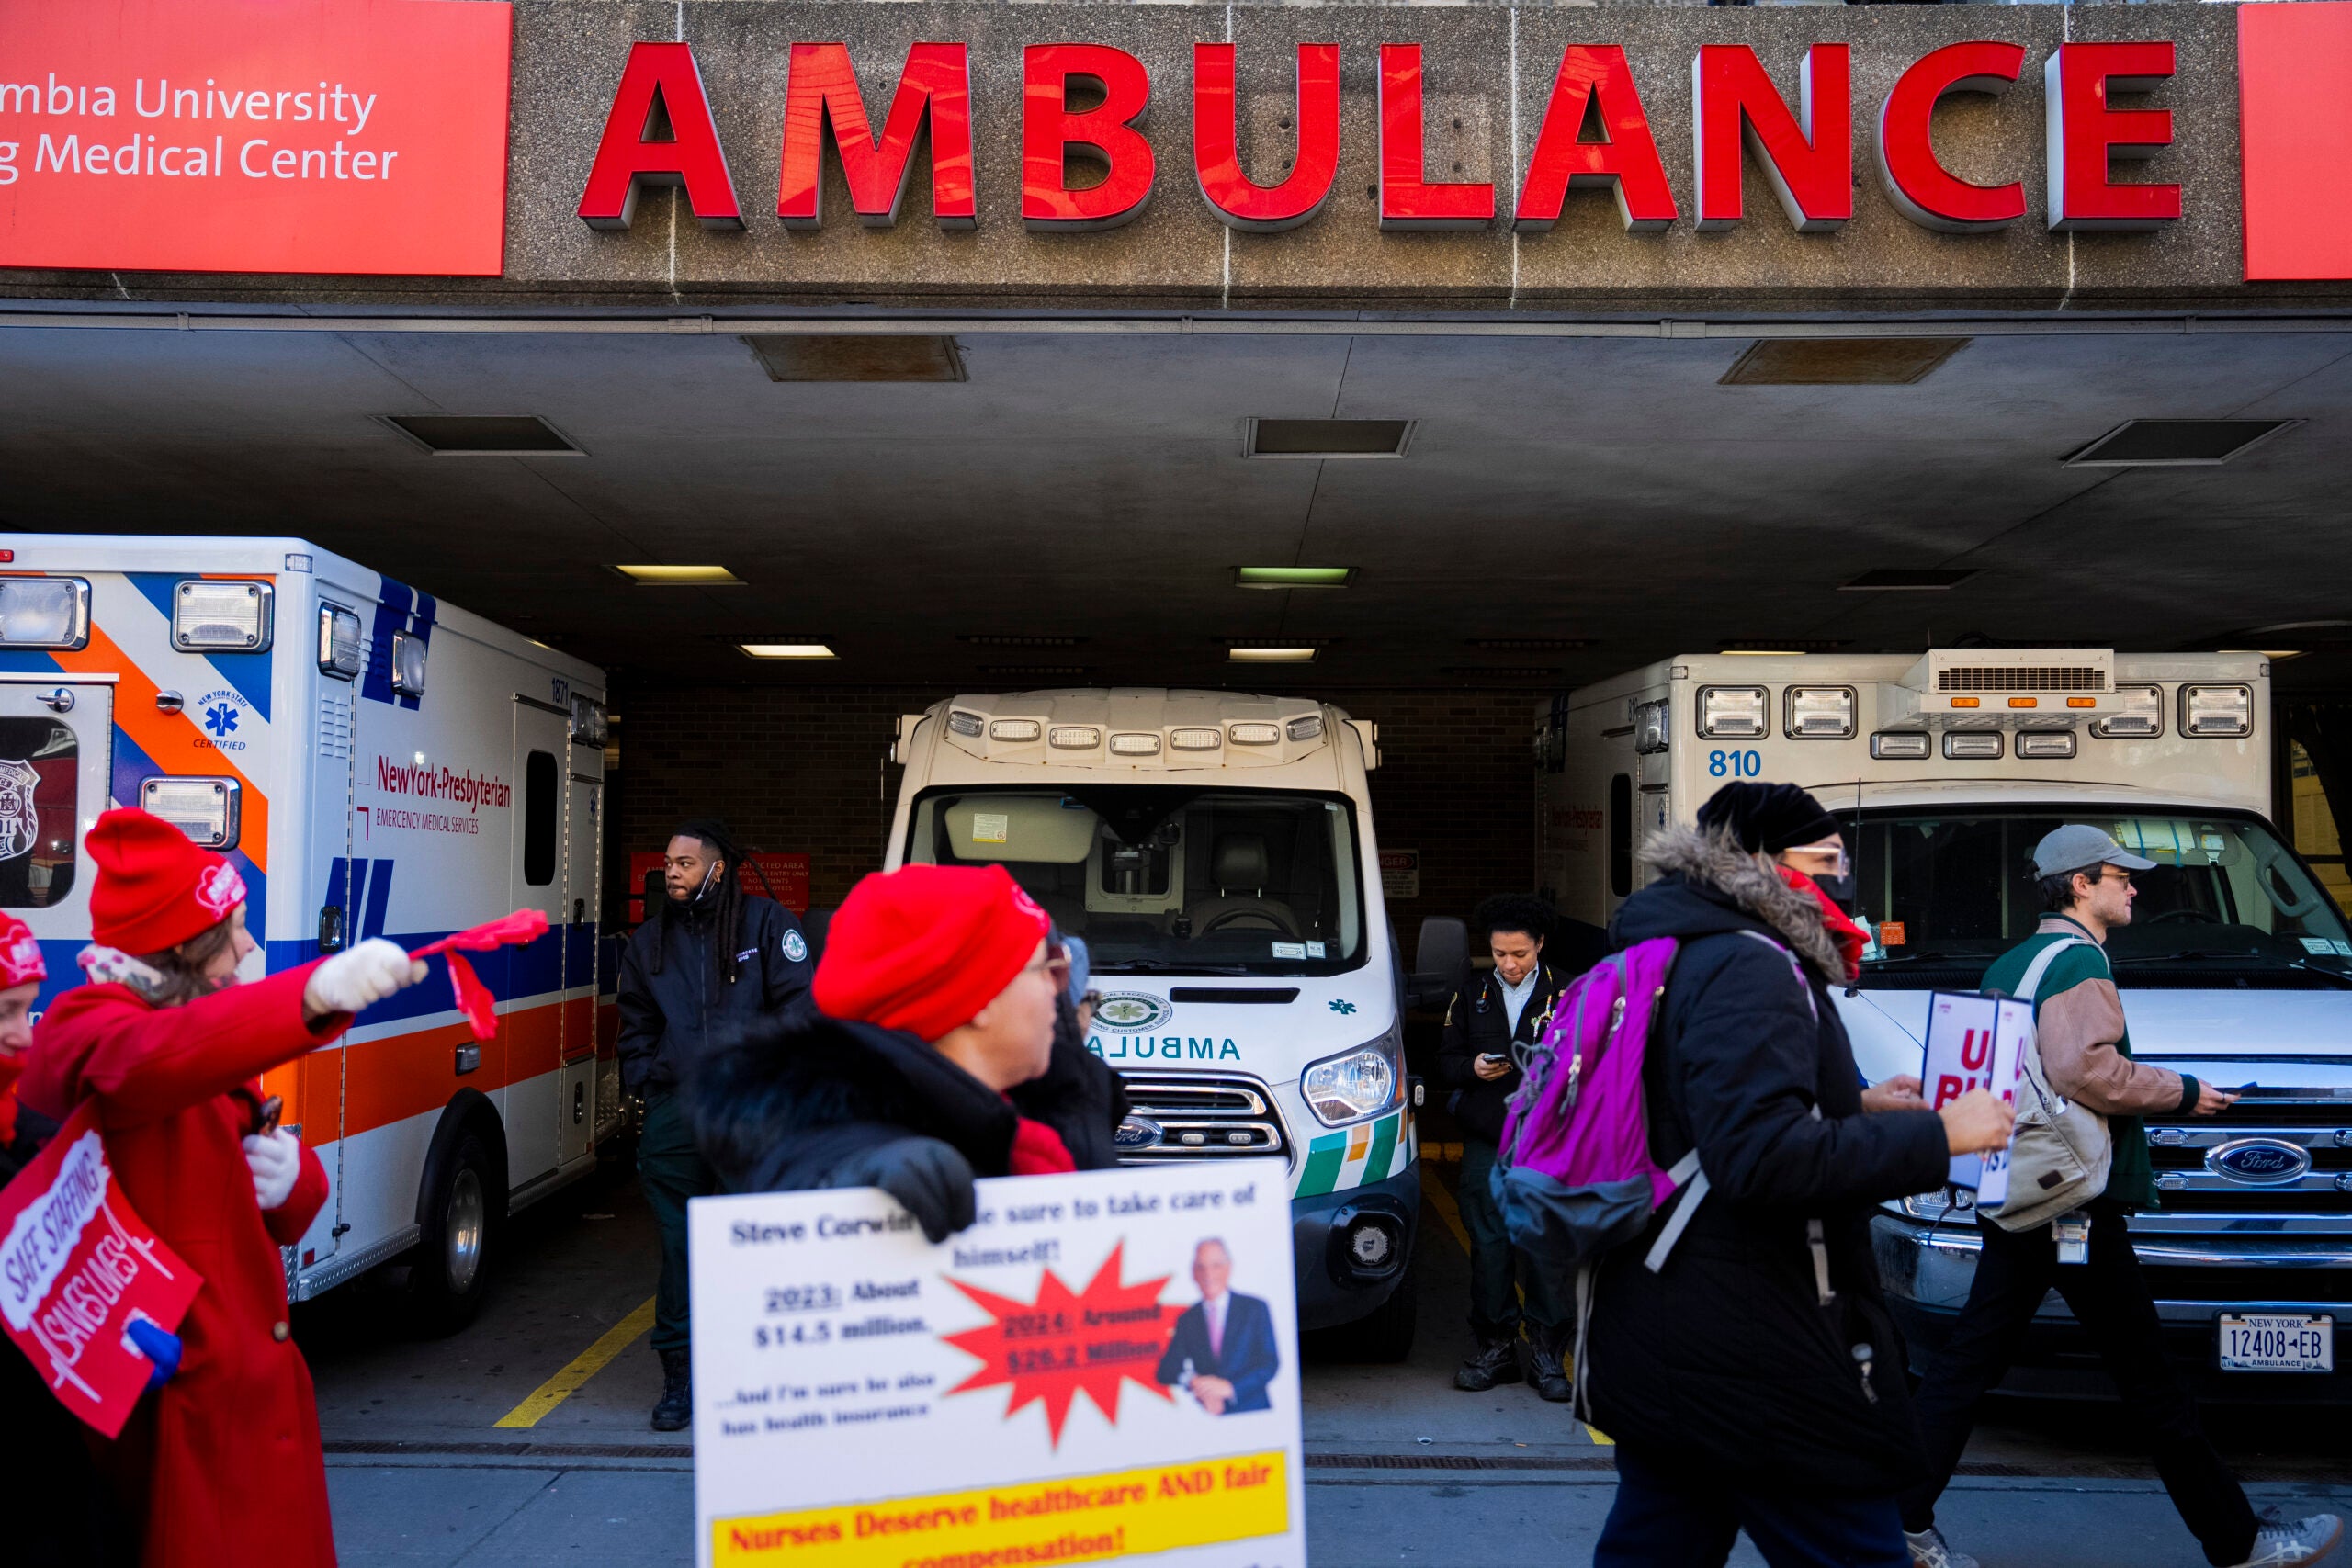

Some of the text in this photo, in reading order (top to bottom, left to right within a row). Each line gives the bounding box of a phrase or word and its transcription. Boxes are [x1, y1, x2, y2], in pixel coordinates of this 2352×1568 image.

[135, 78, 377, 135] University
[577, 40, 2182, 231] AMBULANCE
[35, 133, 222, 177] Medical
[239, 139, 398, 180] Center
[198, 694, 212, 706] NEW
[232, 693, 248, 708] STATE
[551, 678, 569, 706] 1871
[193, 739, 246, 750] CERTIFIED
[1709, 750, 1761, 777] 810
[378, 754, 511, 814] NewYork-Presbyterian
[376, 807, 479, 835] EMERGENCY MEDICAL SERVICES
[1112, 1023, 1155, 1032] CUSTOMER
[2241, 1151, 2284, 1169] Ford
[5, 1150, 99, 1303] SAFE STAFFING
[730, 1220, 805, 1245] Steve
[1008, 1203, 1063, 1225] sure
[1073, 1198, 1098, 1217] to
[1107, 1192, 1160, 1215] take
[1170, 1189, 1225, 1211] care
[1233, 1183, 1257, 1204] of
[953, 1238, 1060, 1269] himself!
[43, 1234, 139, 1367] SAVES LIVES
[765, 1280, 921, 1313] 2023: About
[755, 1322, 830, 1348] $14.5
[2249, 1318, 2304, 1329] NEW YORK
[778, 1385, 808, 1400] I'm
[764, 1413, 826, 1431] health
[834, 1404, 930, 1424] insurance
[729, 1461, 1273, 1551] Nurses Deserve healthcare AND fair
